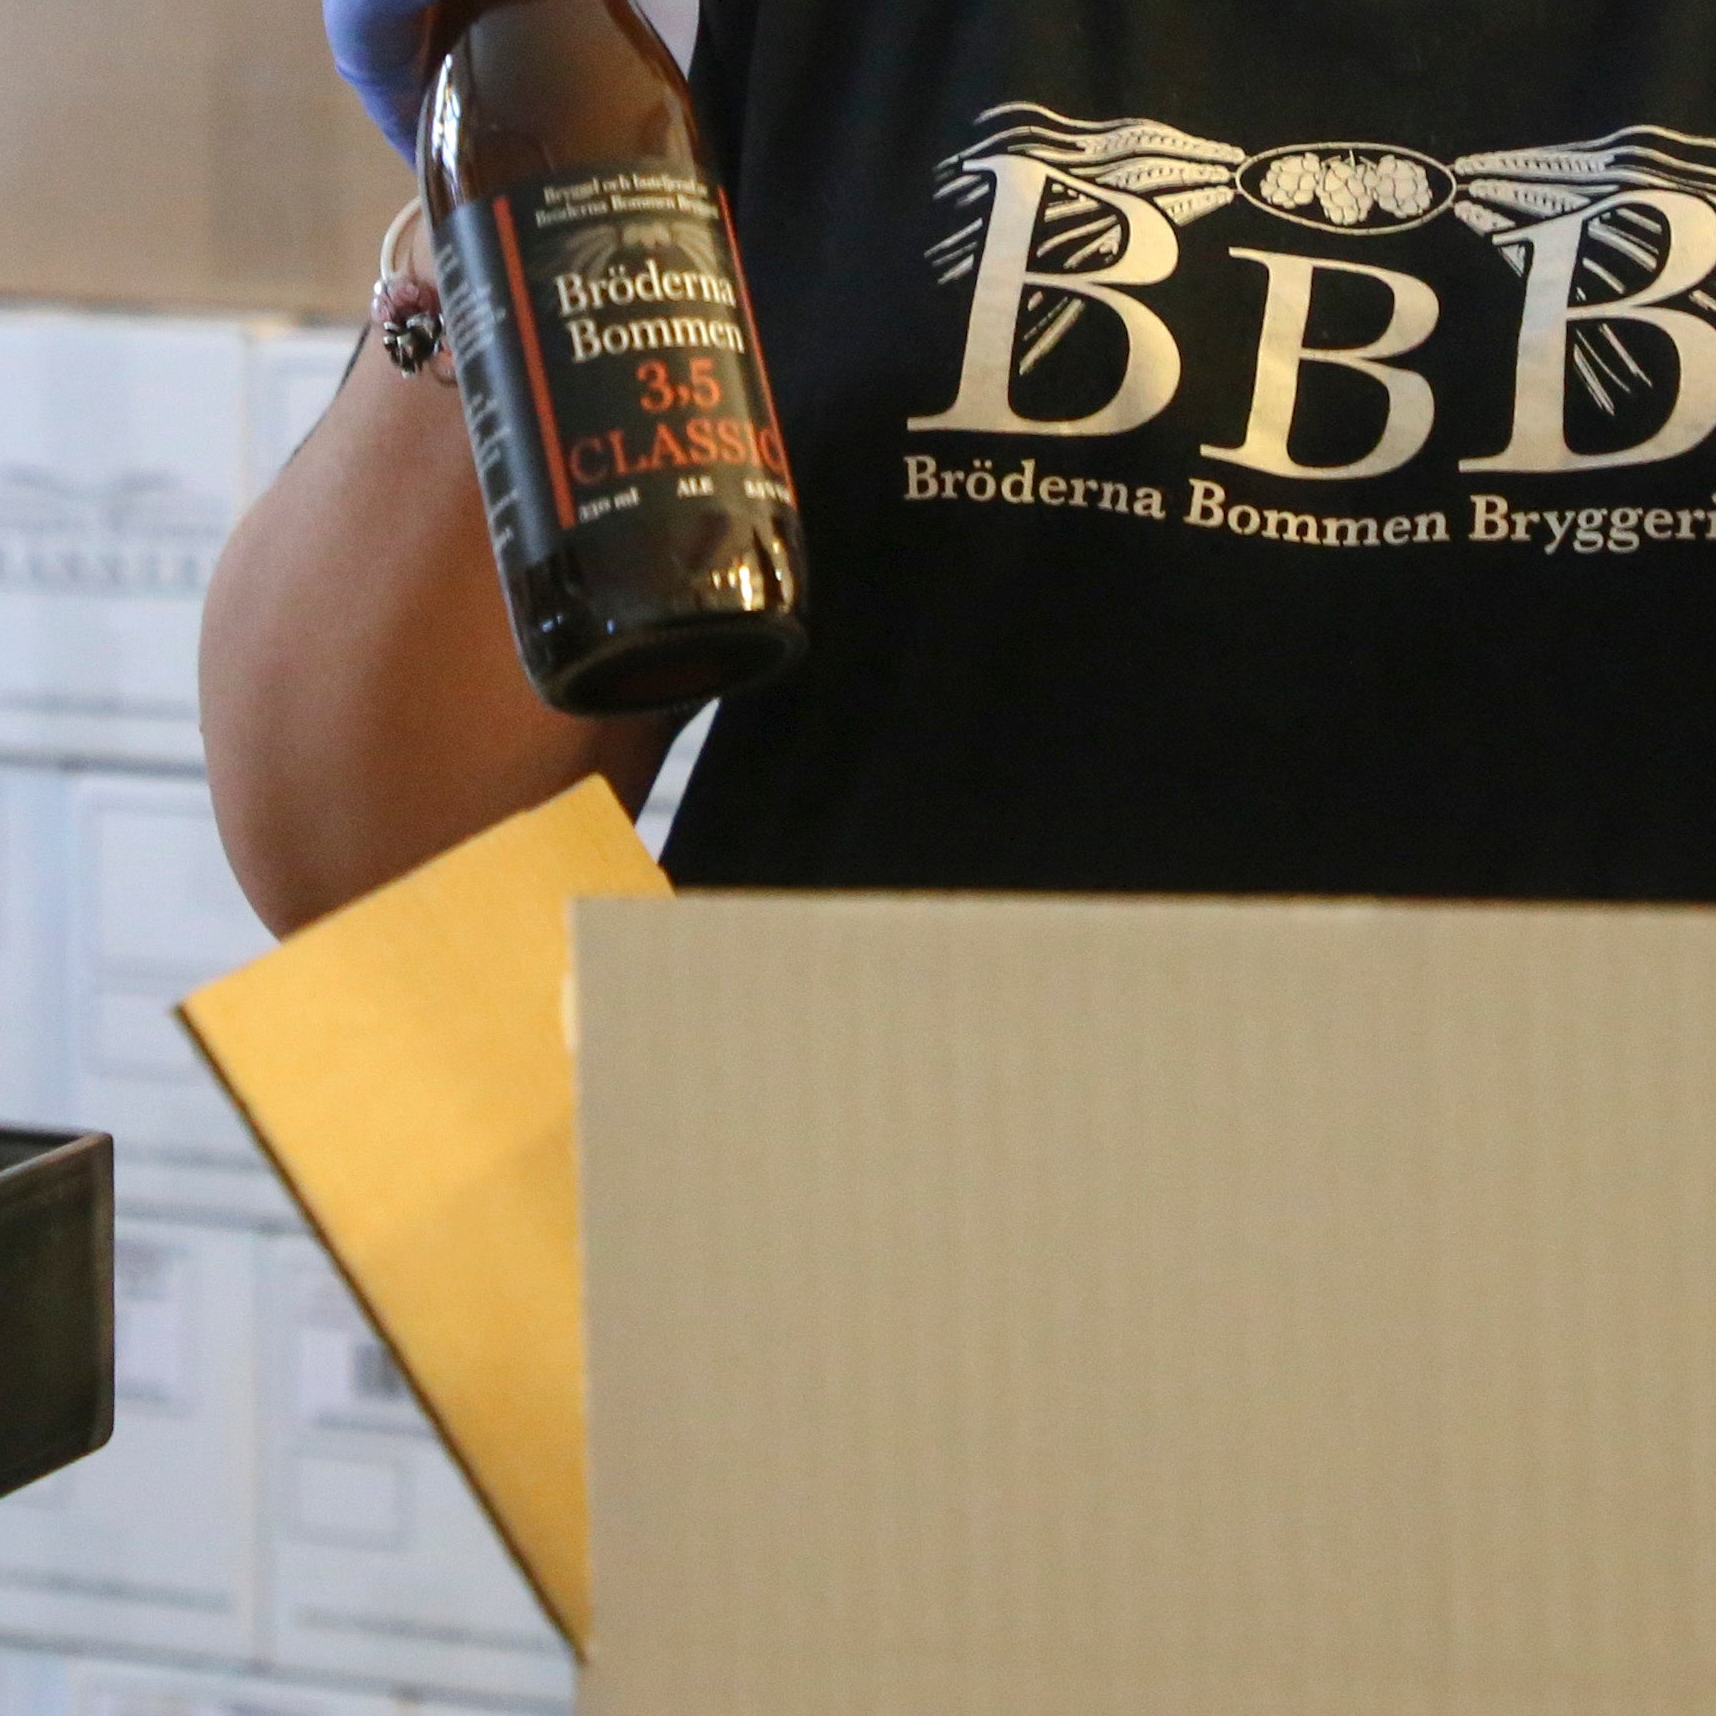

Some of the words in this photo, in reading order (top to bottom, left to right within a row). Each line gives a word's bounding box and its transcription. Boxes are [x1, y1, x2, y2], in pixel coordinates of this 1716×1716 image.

[555, 259, 737, 318] Bröderna
[565, 317, 745, 364] Bommen
[569, 416, 790, 485] CLASSIC
[676, 475, 715, 499] ALE
[903, 455, 1166, 521] Bröderna
[1188, 478, 1452, 549] Bommen
